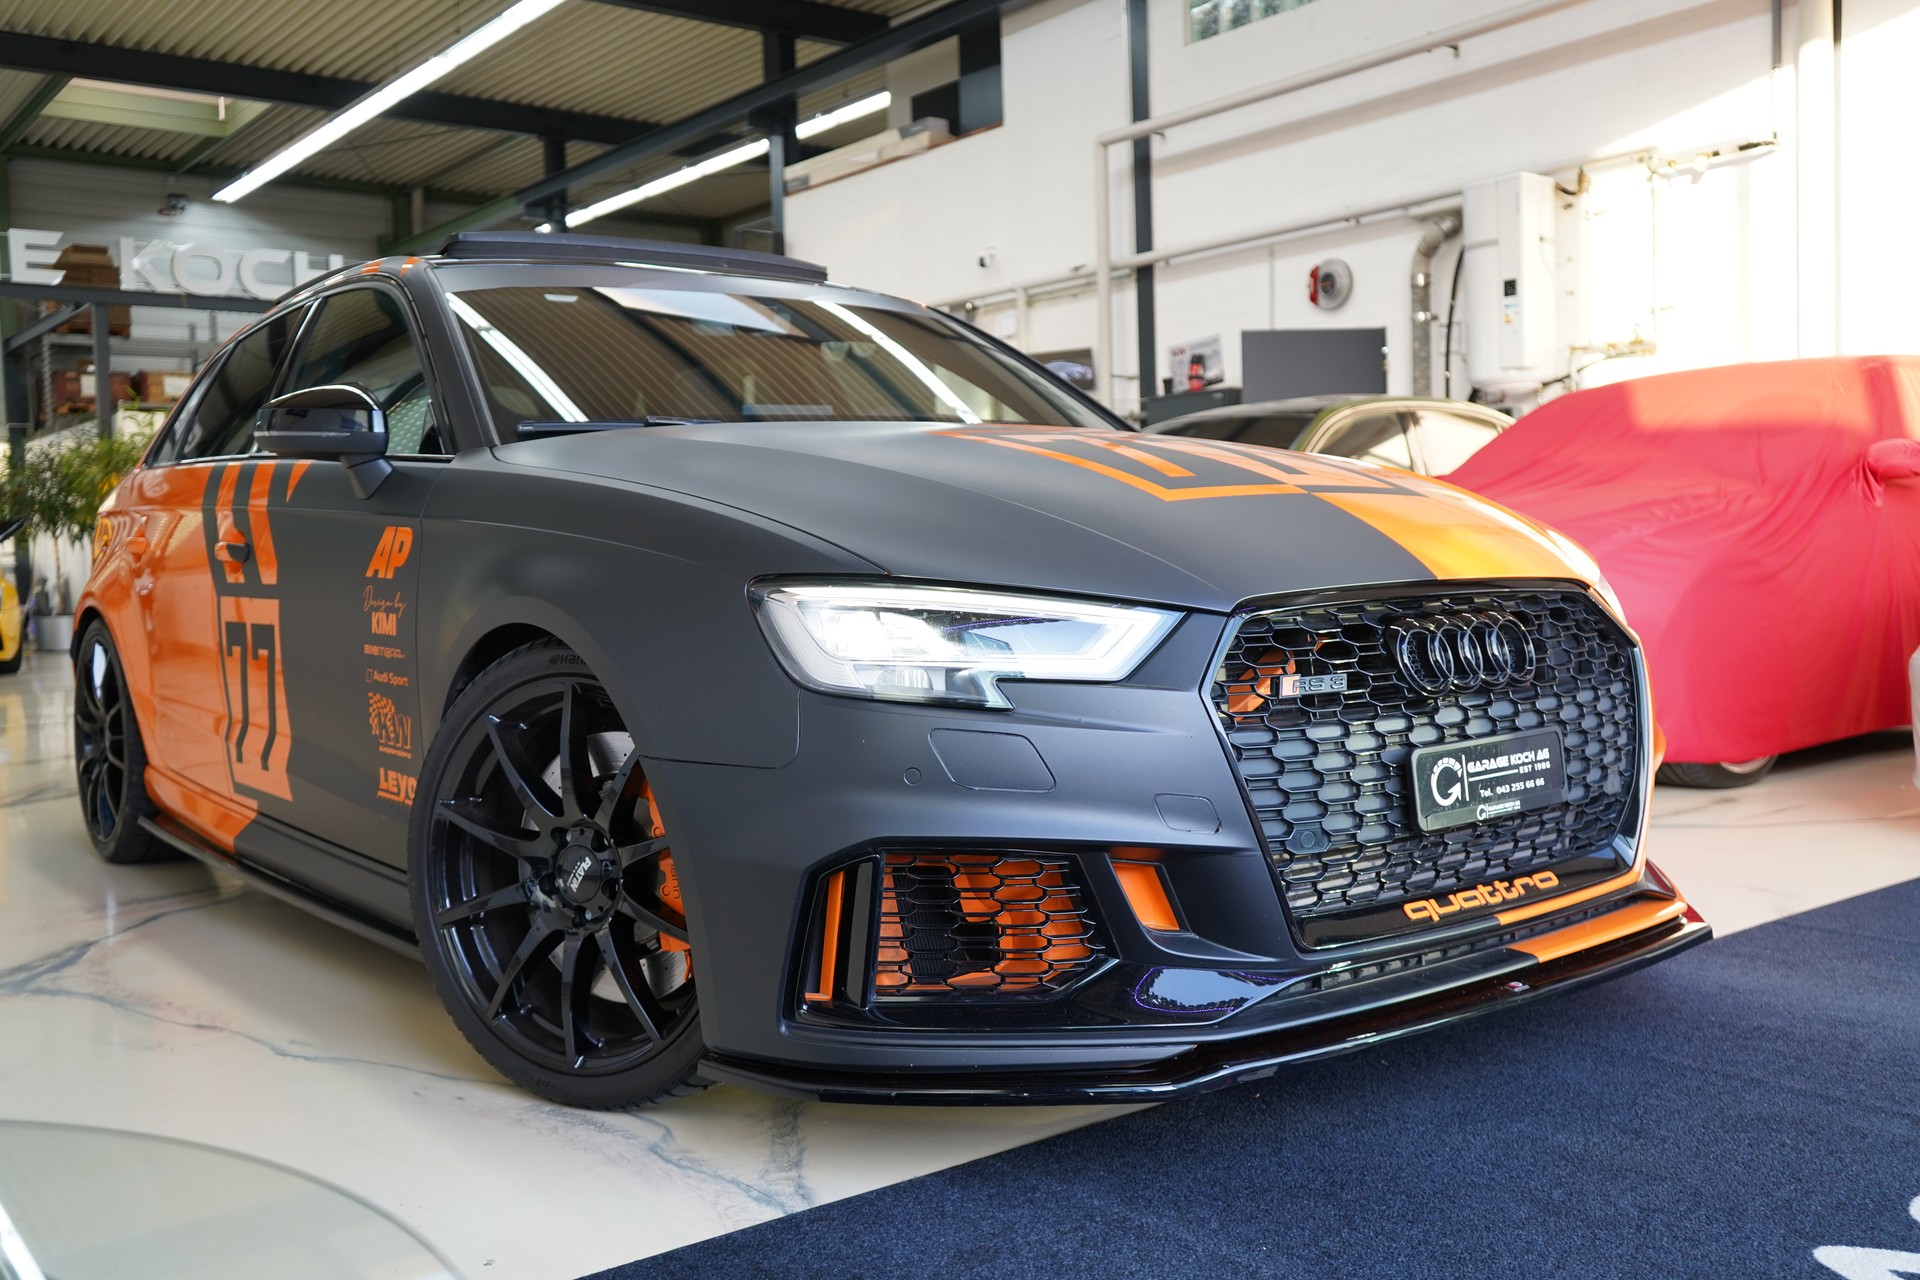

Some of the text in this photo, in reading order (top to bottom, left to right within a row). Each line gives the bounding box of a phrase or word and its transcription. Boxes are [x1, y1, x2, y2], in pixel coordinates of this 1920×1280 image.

[120, 236, 344, 300] KOCH
[365, 526, 413, 579] AP
[371, 611, 397, 636] KIMI
[373, 670, 409, 687] Audi Sport
[1291, 675, 1346, 693] RS 3
[1467, 748, 1550, 774] GARAGE KOCH AG
[1519, 764, 1533, 774] EST
[1479, 777, 1545, 798] Tel. 043 255 66 66
[570, 856, 592, 893] PLATIN
[1403, 870, 1559, 922] quattro
